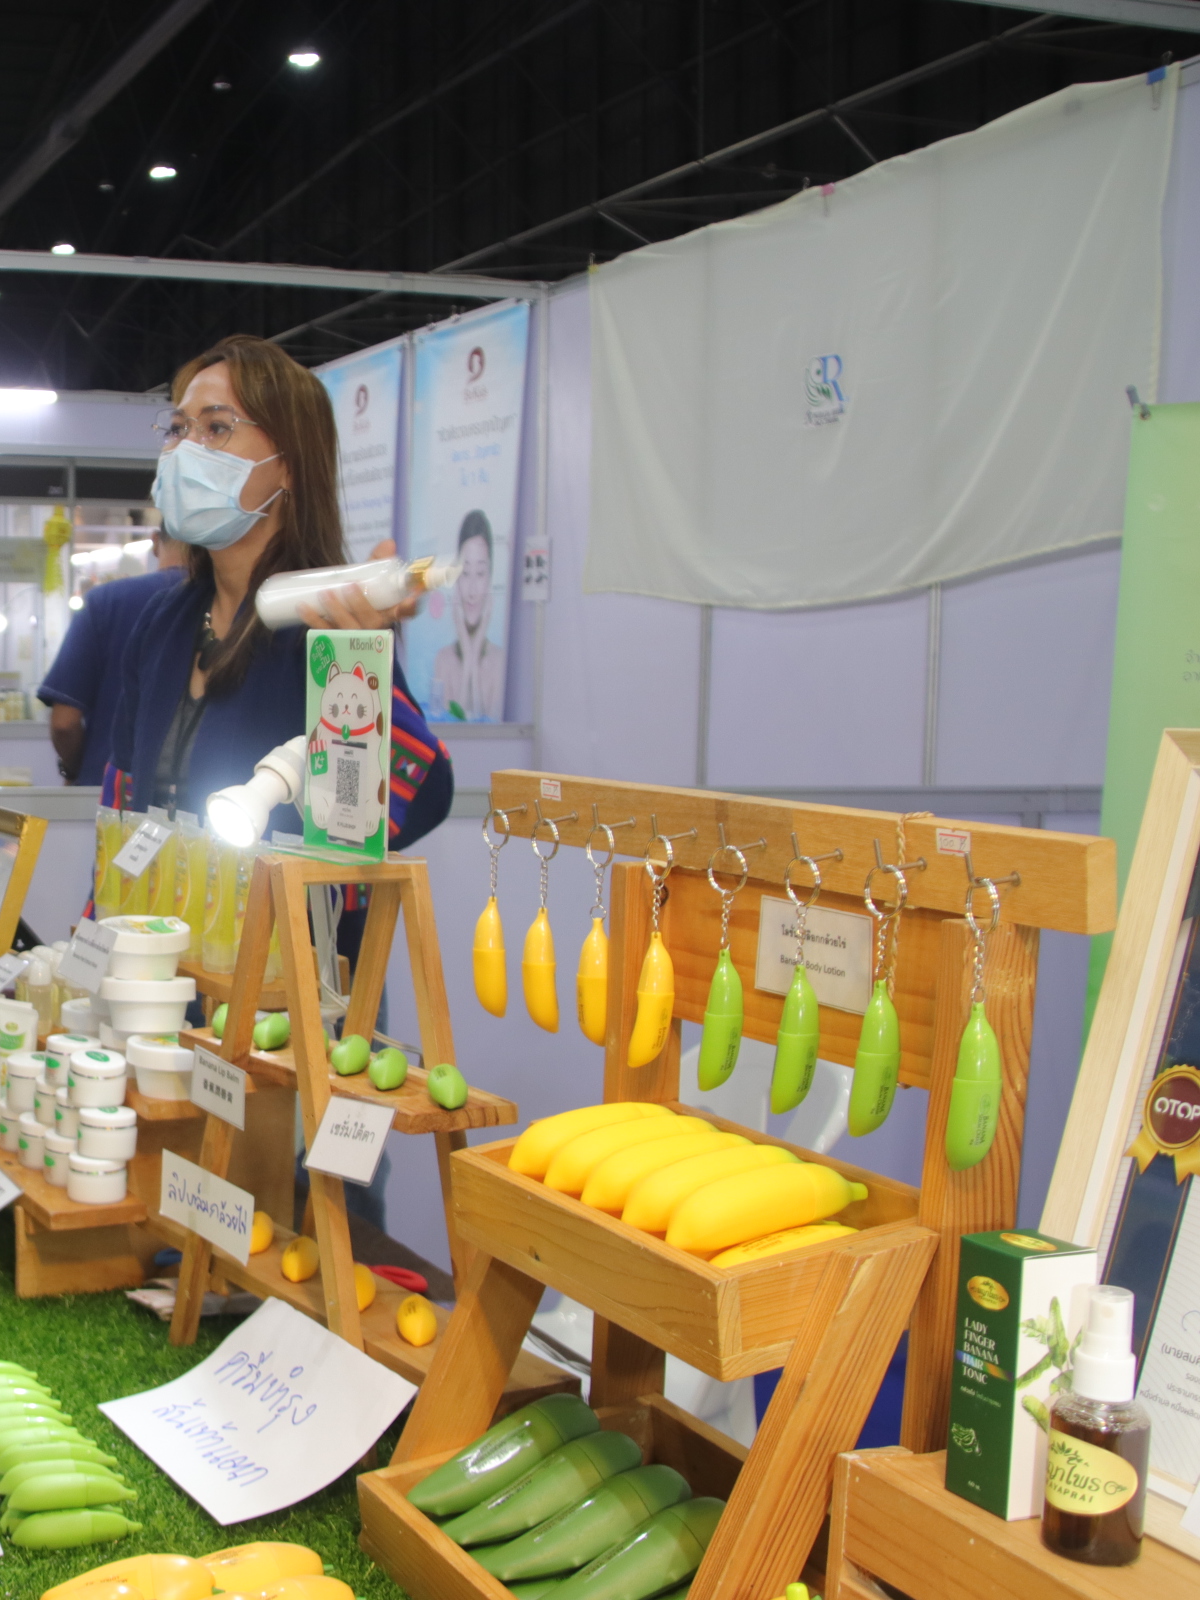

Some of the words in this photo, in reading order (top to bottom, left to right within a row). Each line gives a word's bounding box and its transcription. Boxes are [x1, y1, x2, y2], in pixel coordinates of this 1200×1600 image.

[349, 637, 374, 652] KBank
[805, 960, 822, 973] Body
[823, 963, 846, 978] Lotion
[964, 1317, 989, 1335] LADY
[964, 1329, 997, 1351] FINGER
[962, 1353, 984, 1371] HAIR
[963, 1341, 1000, 1365] BANANA
[962, 1365, 989, 1385] TONIC
[214, 1350, 318, 1434] ครีมบำรุง
[1047, 1480, 1094, 1503] AYAPRAI
